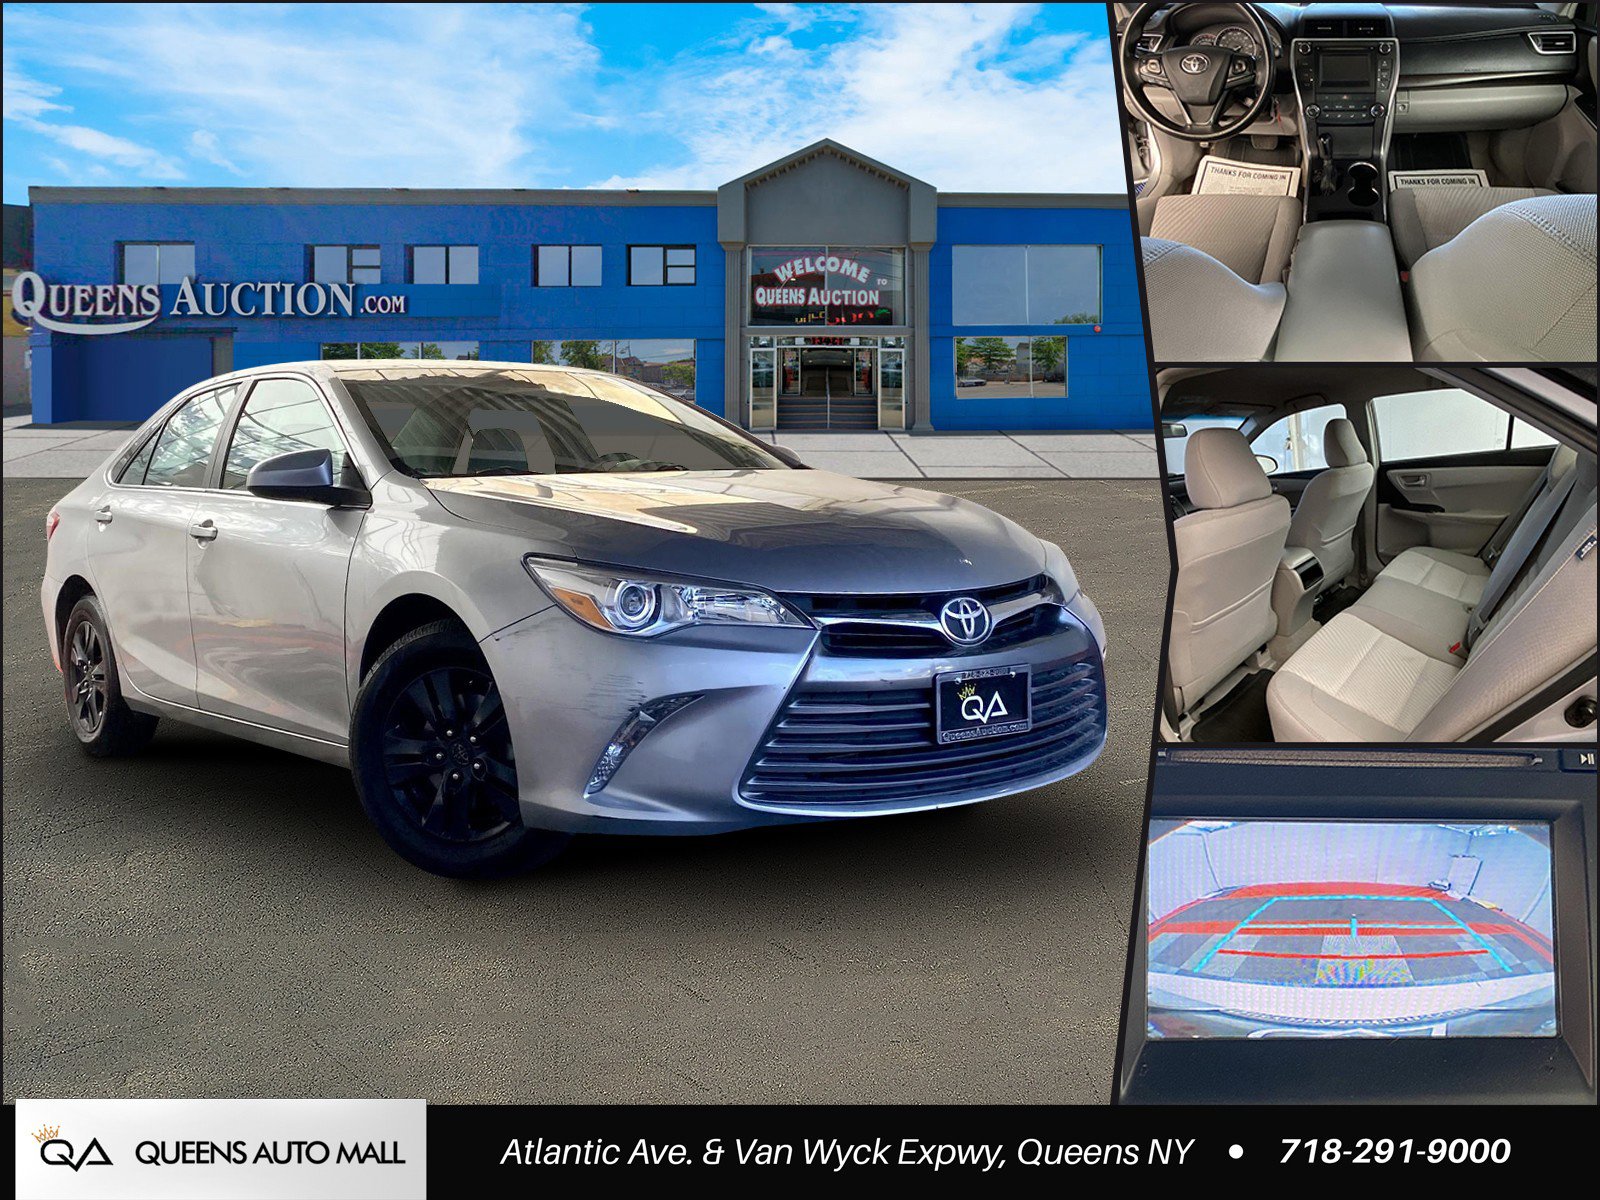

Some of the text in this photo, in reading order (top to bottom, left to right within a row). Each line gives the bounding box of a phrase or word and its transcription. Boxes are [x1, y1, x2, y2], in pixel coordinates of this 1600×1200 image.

[1210, 166, 1237, 178] THANKS
[1237, 171, 1253, 179] FOR
[1252, 173, 1278, 181] COMING
[1400, 177, 1476, 186] THANKS FOR COMING IN
[774, 256, 888, 286] WELCOME TO
[12, 271, 405, 335] QUEENS AUCTION .COM
[755, 287, 880, 306] QUEENS AUCTION
[942, 722, 1028, 742] QueensAuction.com
